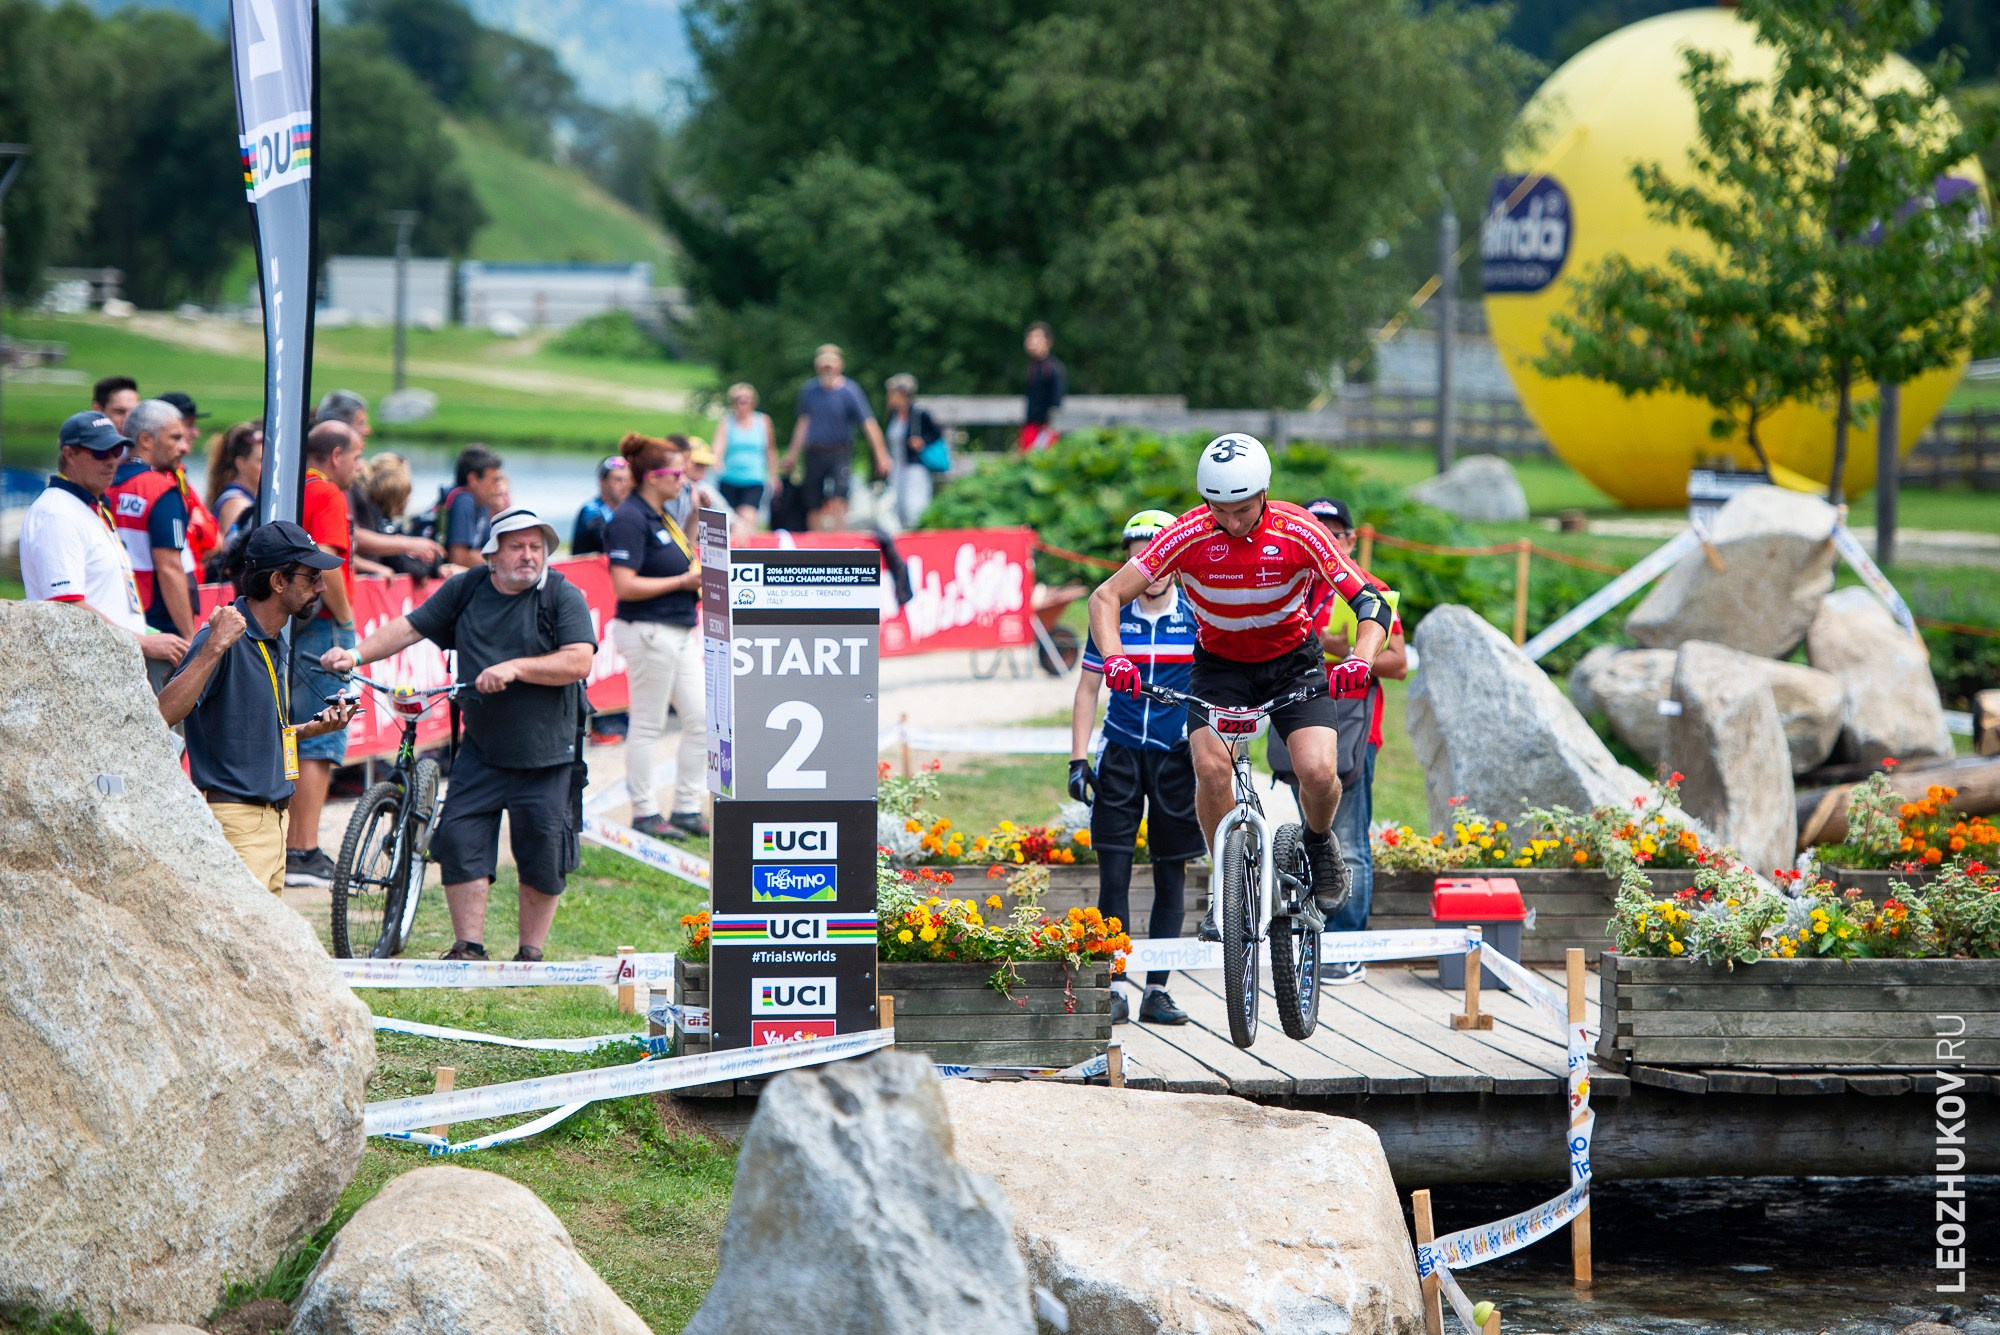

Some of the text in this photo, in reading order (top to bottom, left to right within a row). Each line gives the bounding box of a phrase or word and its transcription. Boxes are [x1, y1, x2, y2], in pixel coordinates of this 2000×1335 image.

[1158, 523, 1202, 558] postnord
[1287, 522, 1331, 560] postnord
[766, 575, 795, 583] WORLD
[796, 575, 859, 583] CHAMPIONSHIPS
[784, 567, 824, 575] MOUNTAIN
[826, 567, 843, 575] BIKE
[844, 567, 850, 575] &
[851, 567, 876, 575] TRIALS
[733, 637, 869, 676] START
[765, 700, 827, 789] 2
[775, 831, 827, 851] UCI
[764, 871, 826, 890] TRENTINO
[770, 919, 819, 939] UCI
[752, 950, 837, 963] #TrialsWorlds
[774, 985, 826, 1006] UCI
